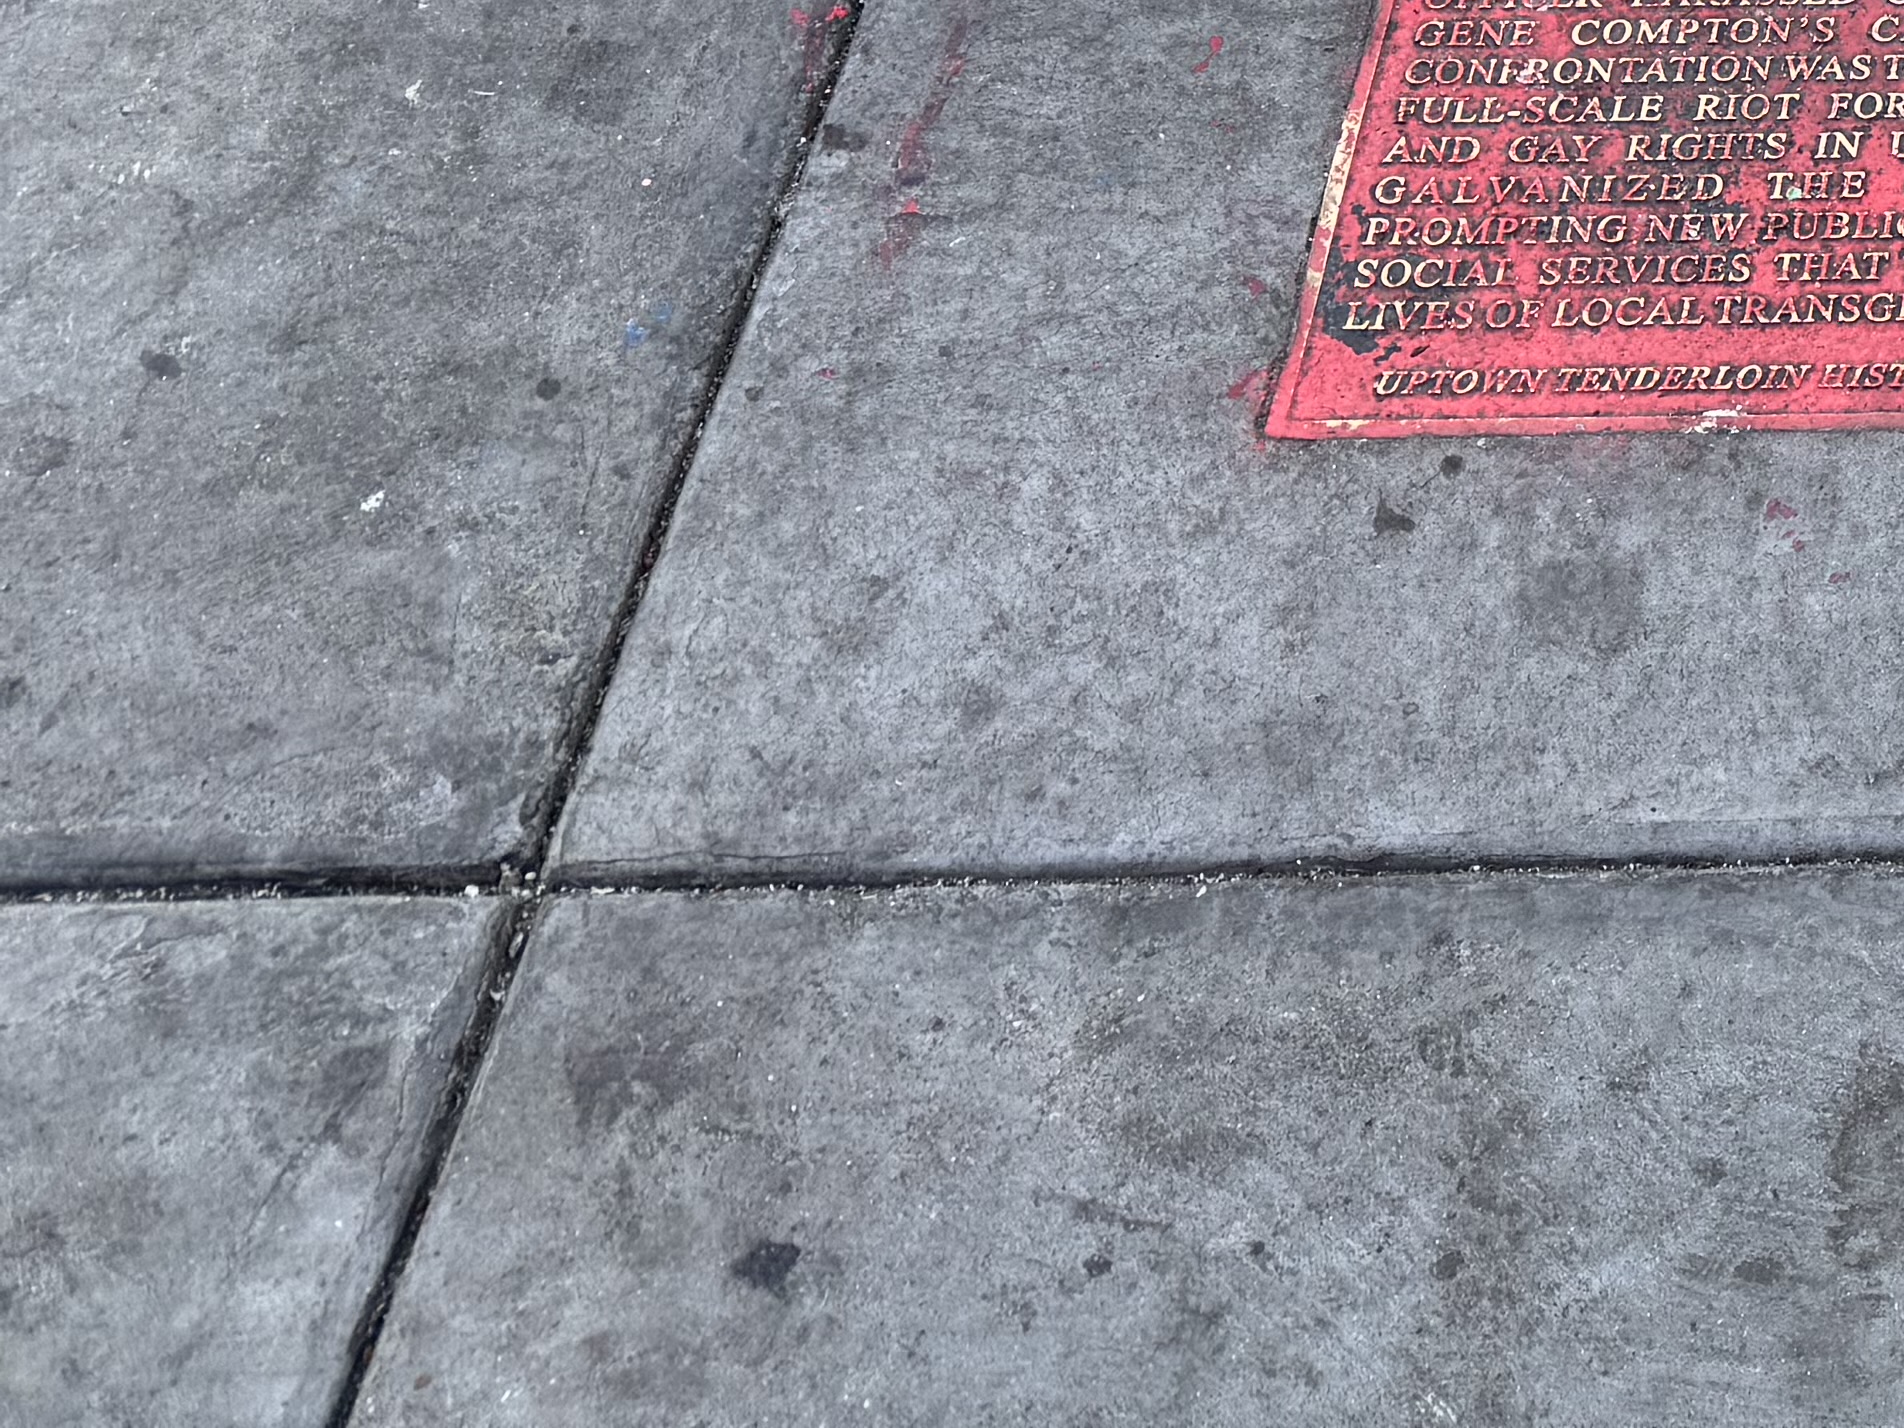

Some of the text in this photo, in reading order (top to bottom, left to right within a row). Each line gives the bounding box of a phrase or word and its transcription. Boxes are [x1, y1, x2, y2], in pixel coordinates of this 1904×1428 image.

[1413, 19, 1537, 48] GENE
[1571, 17, 1836, 46] COMPTON'S
[1404, 55, 1775, 85] CONFRONTATION
[1785, 55, 1873, 82] WAS
[1395, 94, 1665, 124] FULL-SCALE
[1696, 92, 1802, 120] RIOT
[1382, 134, 1482, 163] AND
[1507, 132, 1603, 162] GAY
[1624, 131, 1789, 160] RIGHTS
[1814, 131, 1864, 159] IN
[1372, 172, 1724, 204] GALVANIZED
[1766, 171, 1867, 200] THE
[1361, 213, 1626, 245] PROMPTING
[1644, 212, 1749, 242] NEW
[1352, 255, 1513, 289] SOCIAL
[1537, 254, 1751, 285] SERVICES
[1774, 252, 1890, 283] THAT
[1343, 299, 1476, 332] LIVES
[1485, 297, 1545, 329] OF
[1551, 295, 1706, 329] LOCAL
[1372, 365, 1546, 397] UPTOWN
[1555, 364, 1803, 394] TENDERLOIN
